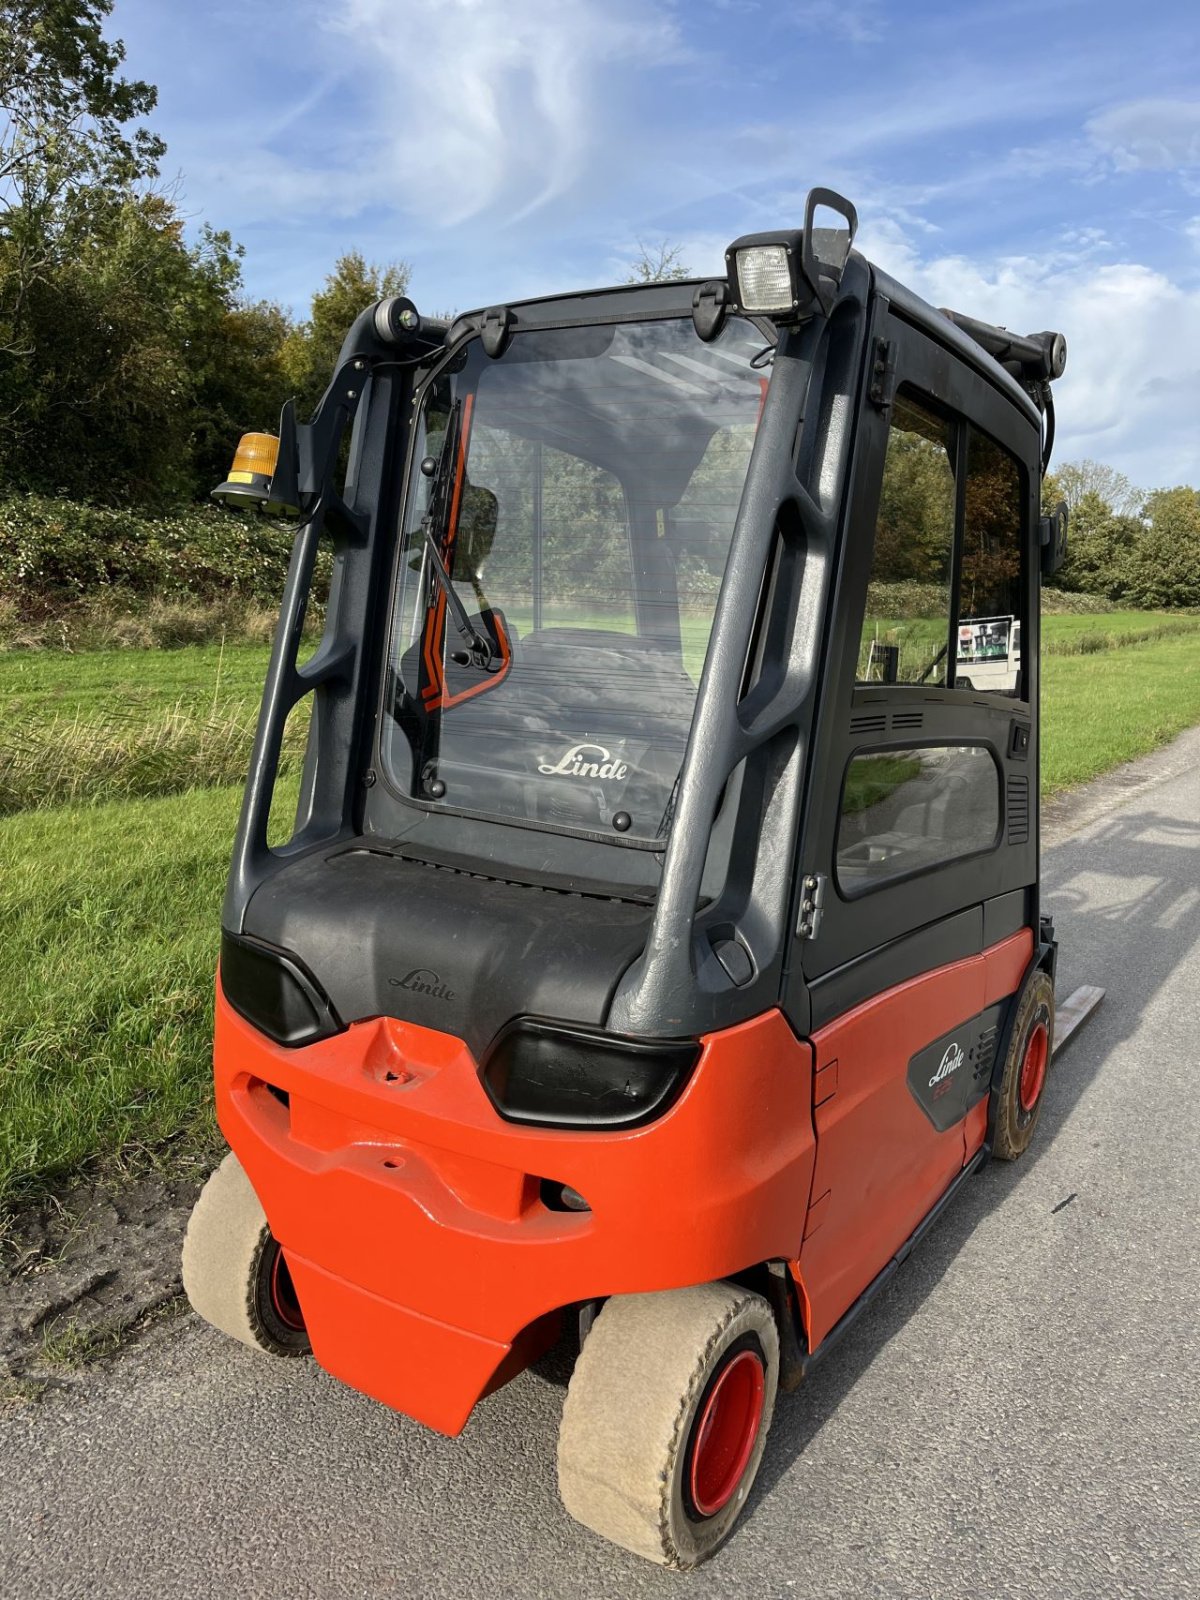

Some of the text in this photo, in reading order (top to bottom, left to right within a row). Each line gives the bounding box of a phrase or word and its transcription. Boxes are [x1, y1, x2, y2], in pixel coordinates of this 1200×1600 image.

[538, 744, 627, 780] Linde
[389, 968, 456, 1001] Linde
[928, 1042, 964, 1087] Linde
